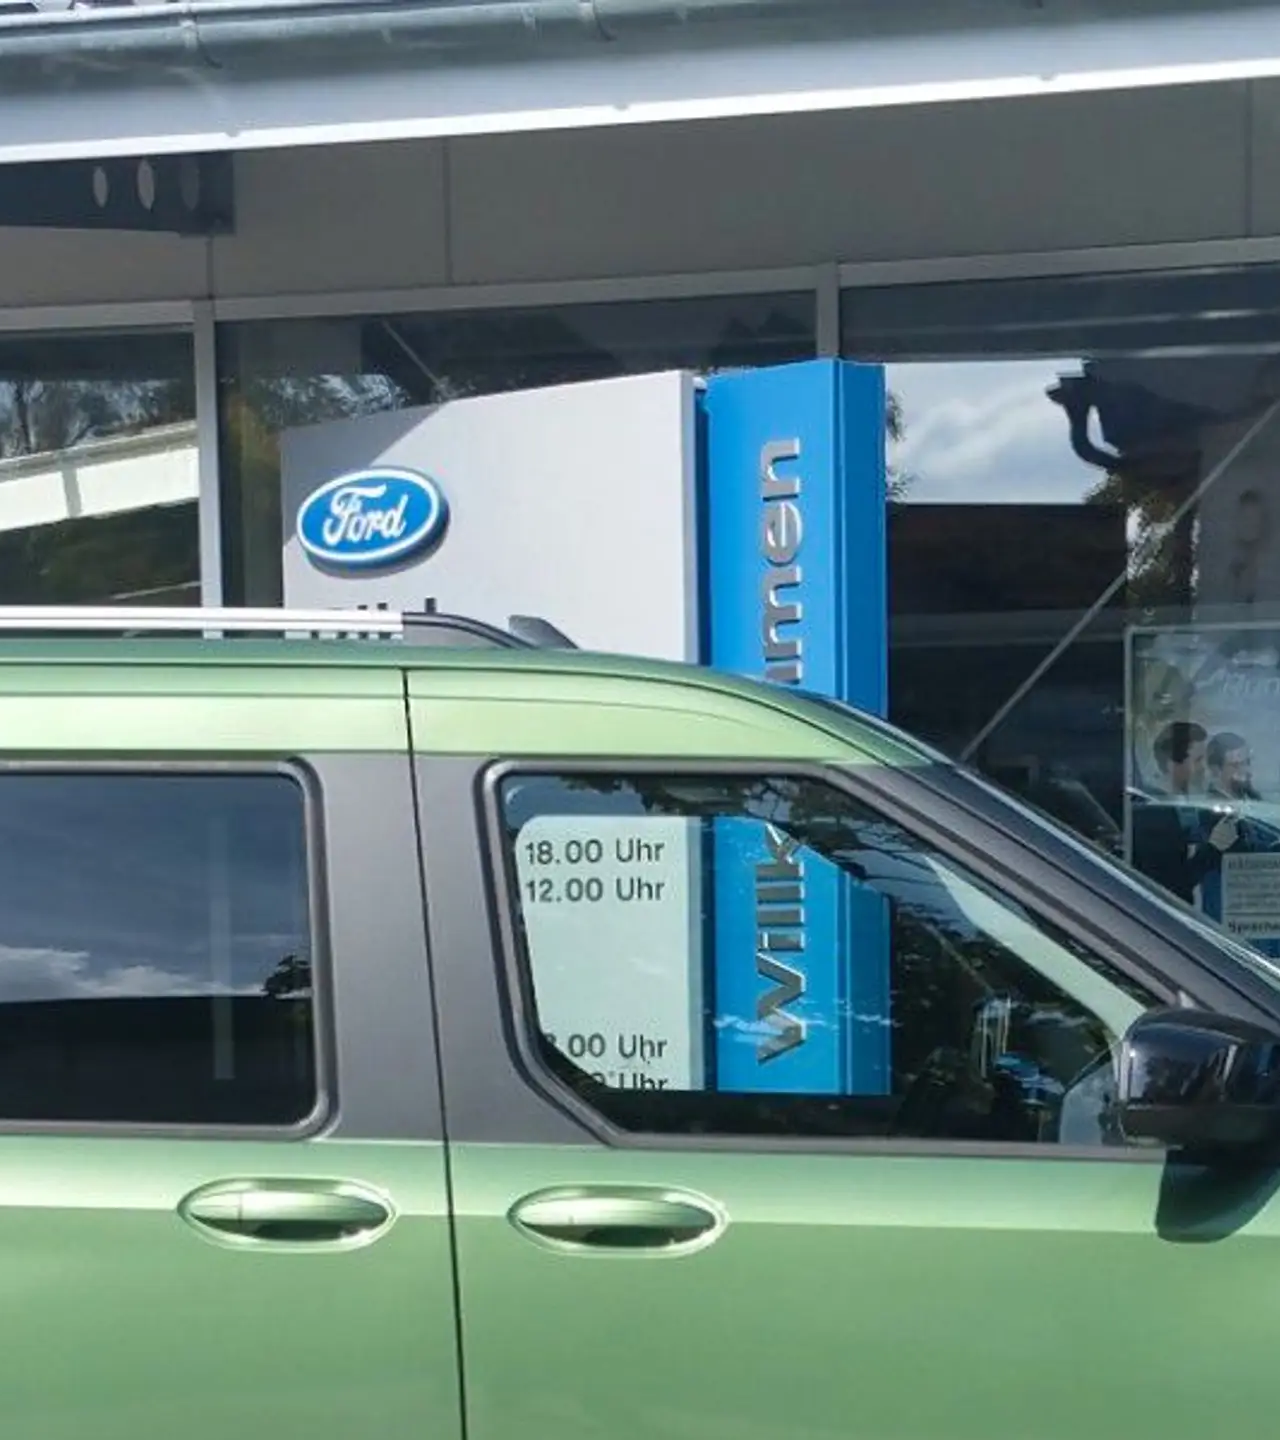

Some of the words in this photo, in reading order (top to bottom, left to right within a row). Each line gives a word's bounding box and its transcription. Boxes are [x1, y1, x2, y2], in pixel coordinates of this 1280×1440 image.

[322, 484, 409, 546] Ford
[525, 839, 603, 865] 18.00
[615, 837, 665, 863] Uhr
[525, 877, 603, 902] 12.00
[615, 877, 665, 901] Uhr
[618, 1033, 667, 1059] Uhr
